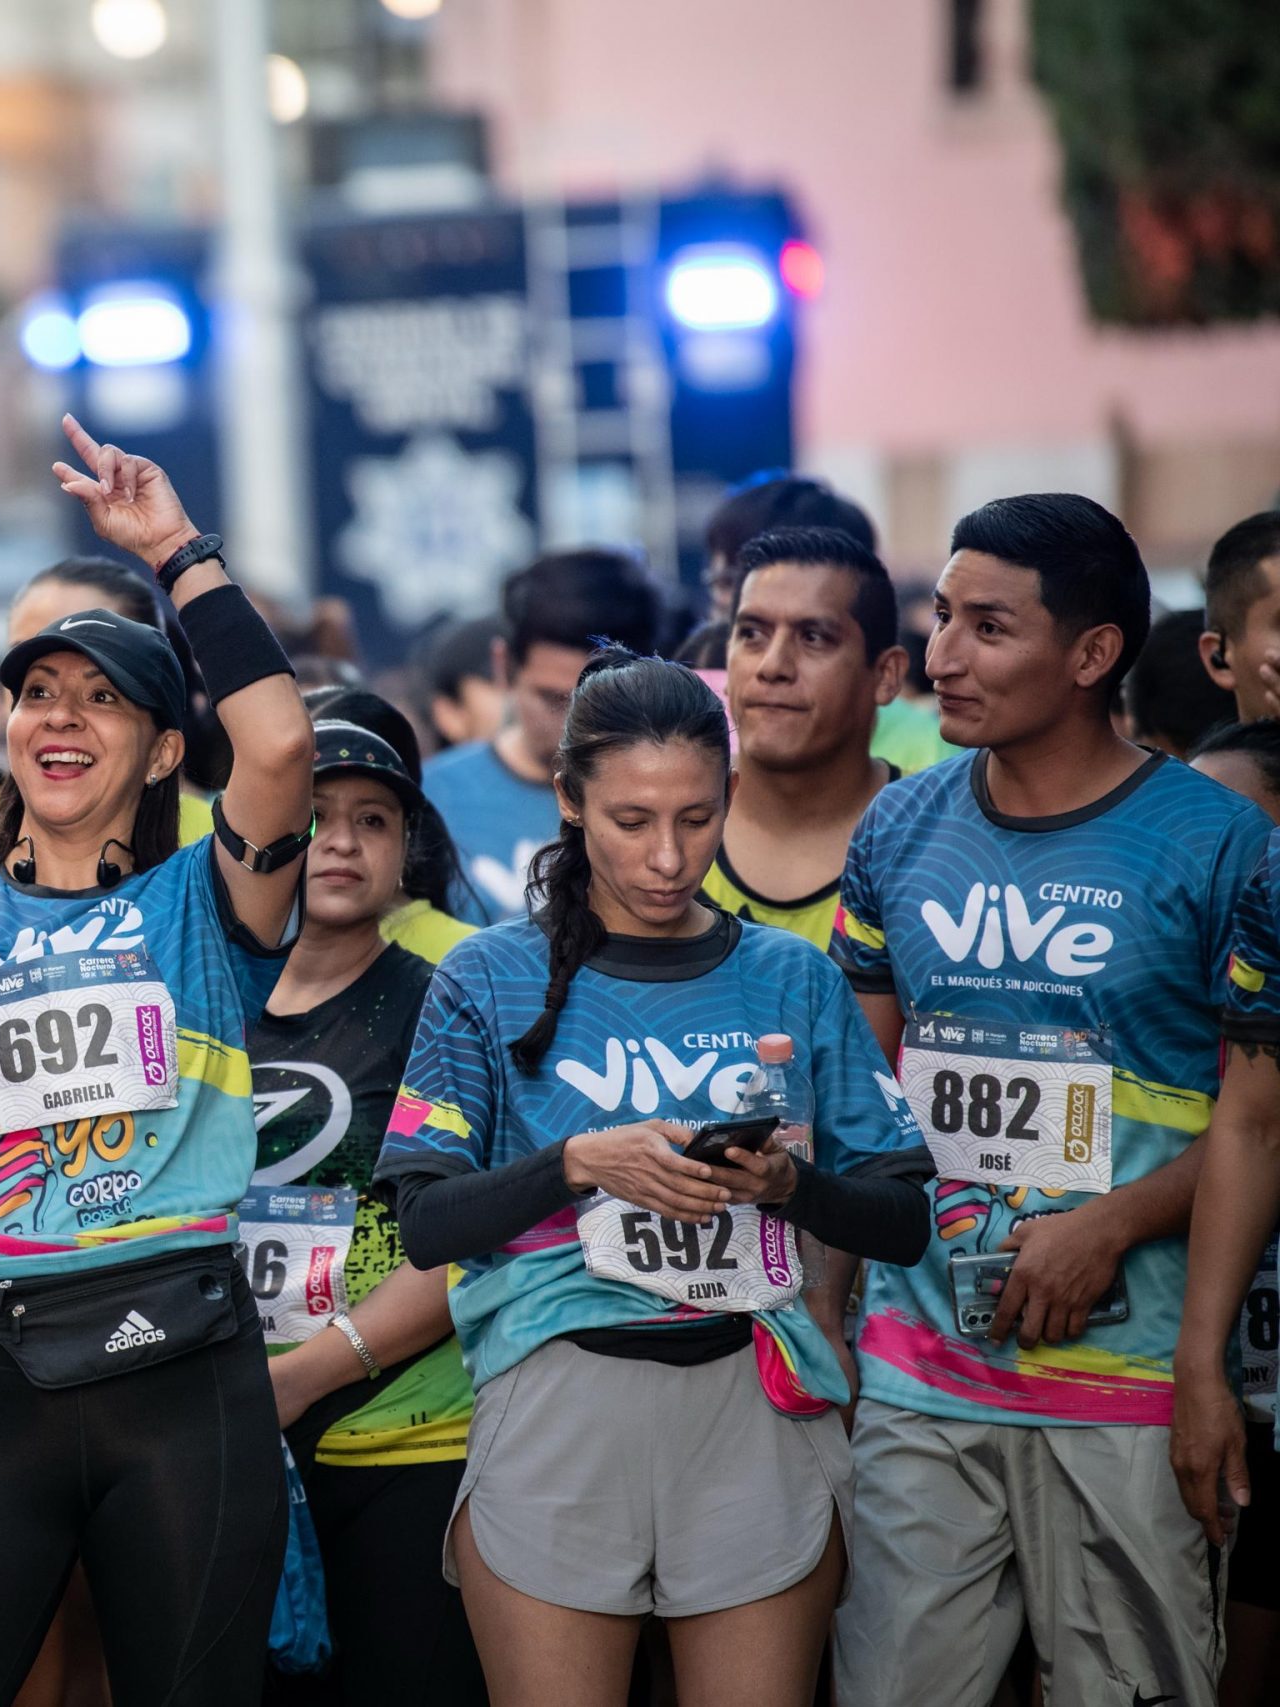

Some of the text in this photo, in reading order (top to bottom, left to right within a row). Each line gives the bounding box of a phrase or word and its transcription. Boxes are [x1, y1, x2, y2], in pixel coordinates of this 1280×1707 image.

[1038, 882, 1123, 909] CENTRO
[931, 975, 1083, 997] EL MARQUÉS SIN ADICCIONES
[1019, 1031, 1057, 1042] Carrera
[1020, 1040, 1057, 1048] Nocturna
[43, 1082, 115, 1110] GABRIELA
[932, 1070, 1041, 1141] 882
[979, 1153, 1012, 1171] JOSÉ
[67, 1170, 142, 1207] CORRO
[77, 1206, 113, 1227] POR
[114, 1197, 133, 1215] LA
[620, 1209, 738, 1273] 592
[688, 1282, 728, 1300] ELVIA
[105, 1329, 166, 1353] adidas
